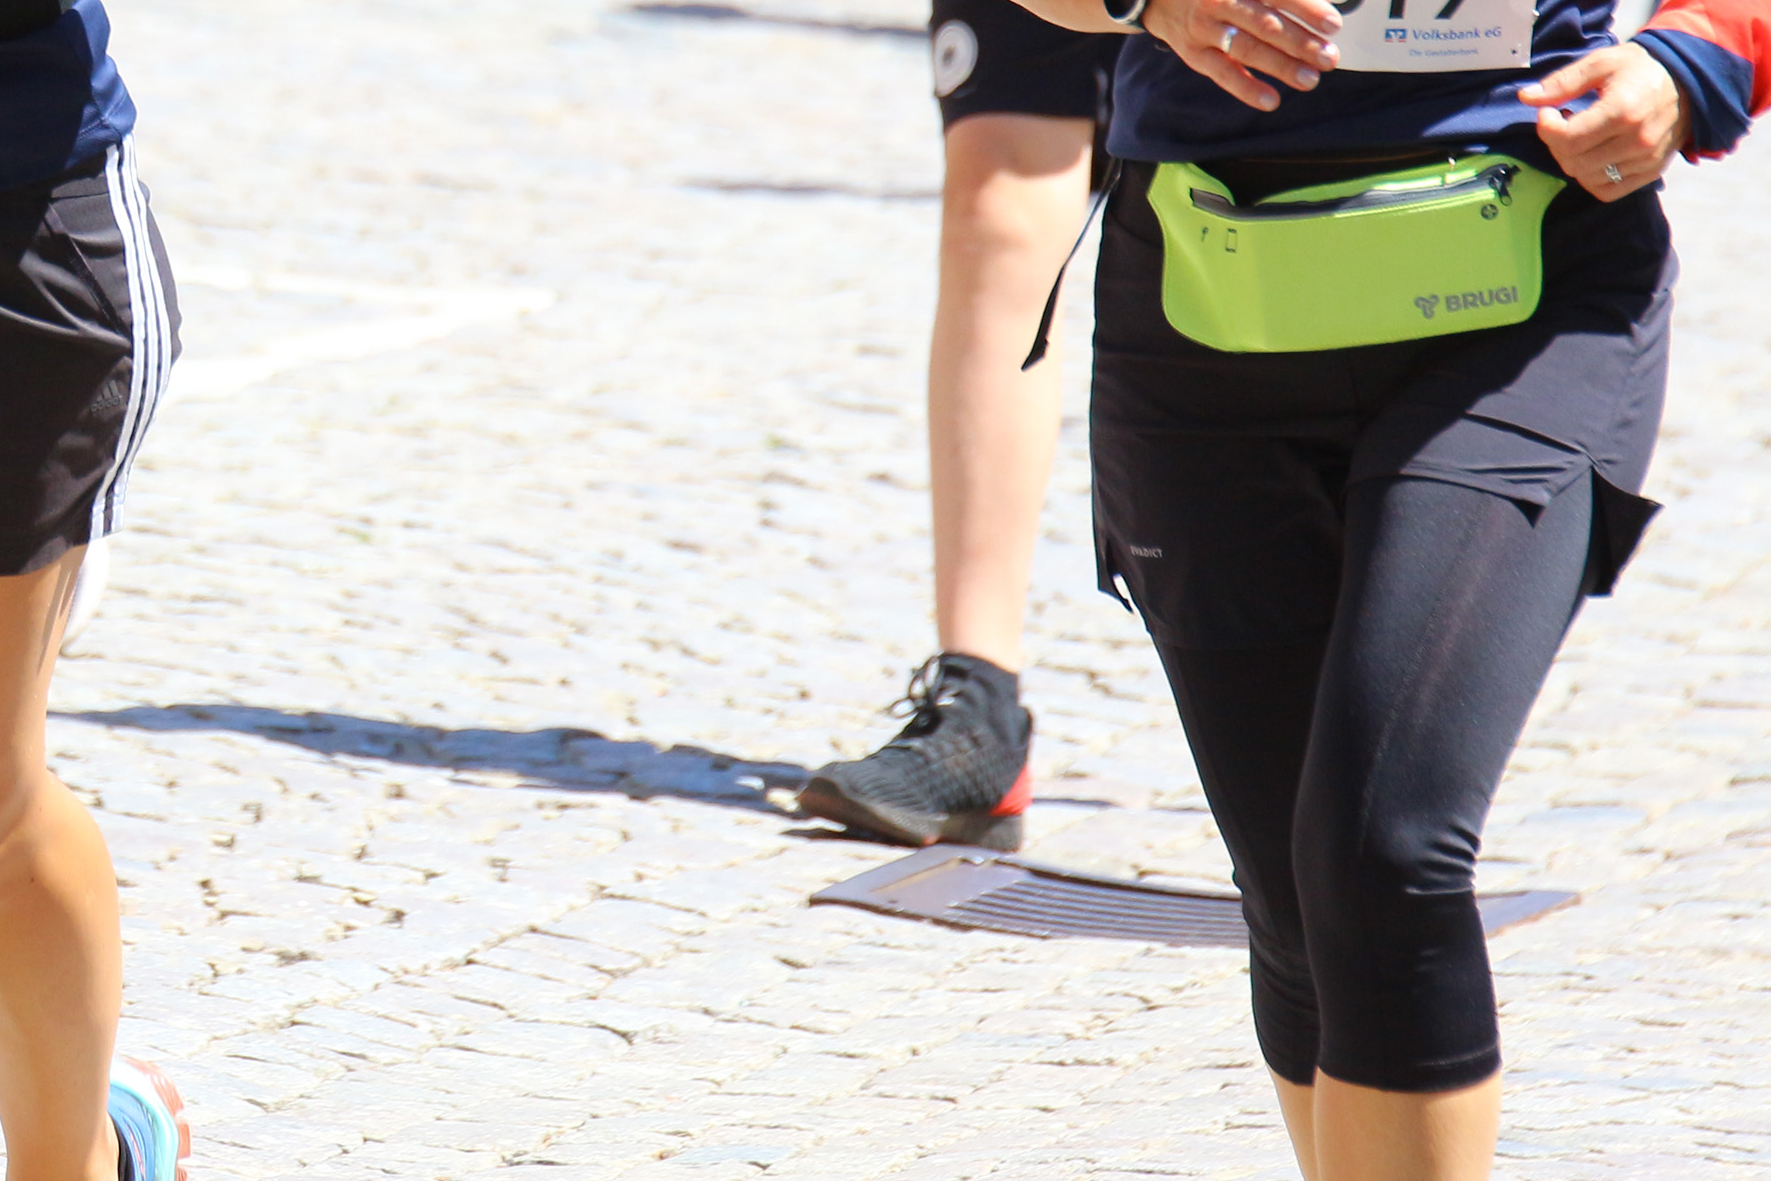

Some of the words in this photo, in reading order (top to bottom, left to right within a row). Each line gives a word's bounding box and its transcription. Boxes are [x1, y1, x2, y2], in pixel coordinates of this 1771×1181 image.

[1413, 28, 1480, 40] Volksbank
[1484, 26, 1502, 38] eG
[1445, 286, 1519, 312] BRUGI
